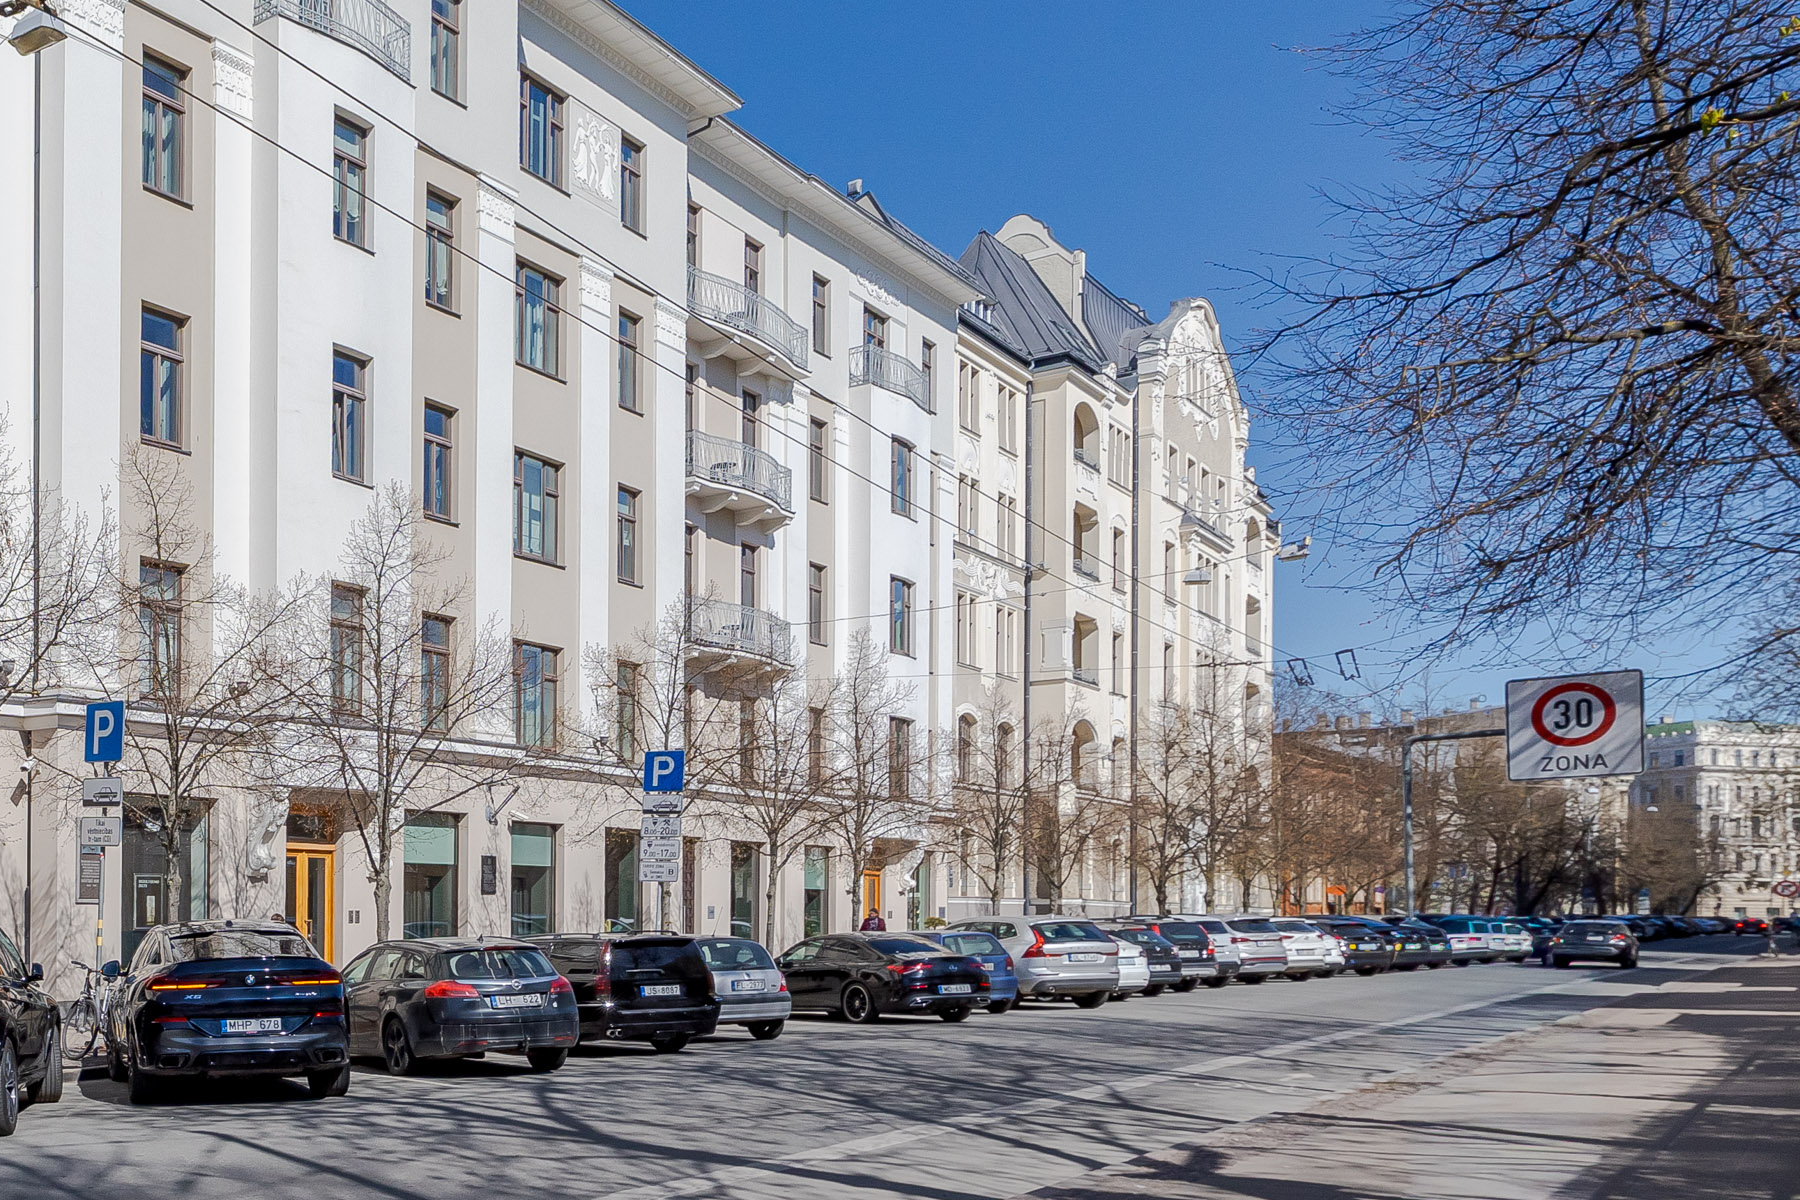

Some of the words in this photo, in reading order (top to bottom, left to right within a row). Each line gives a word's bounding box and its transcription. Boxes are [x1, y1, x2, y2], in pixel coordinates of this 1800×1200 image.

[1553, 698, 1593, 730] 30
[92, 709, 115, 755] P
[652, 756, 675, 787] P
[1540, 753, 1608, 772] ZONA
[228, 1020, 252, 1031] MHP
[259, 1019, 280, 1029] 678
